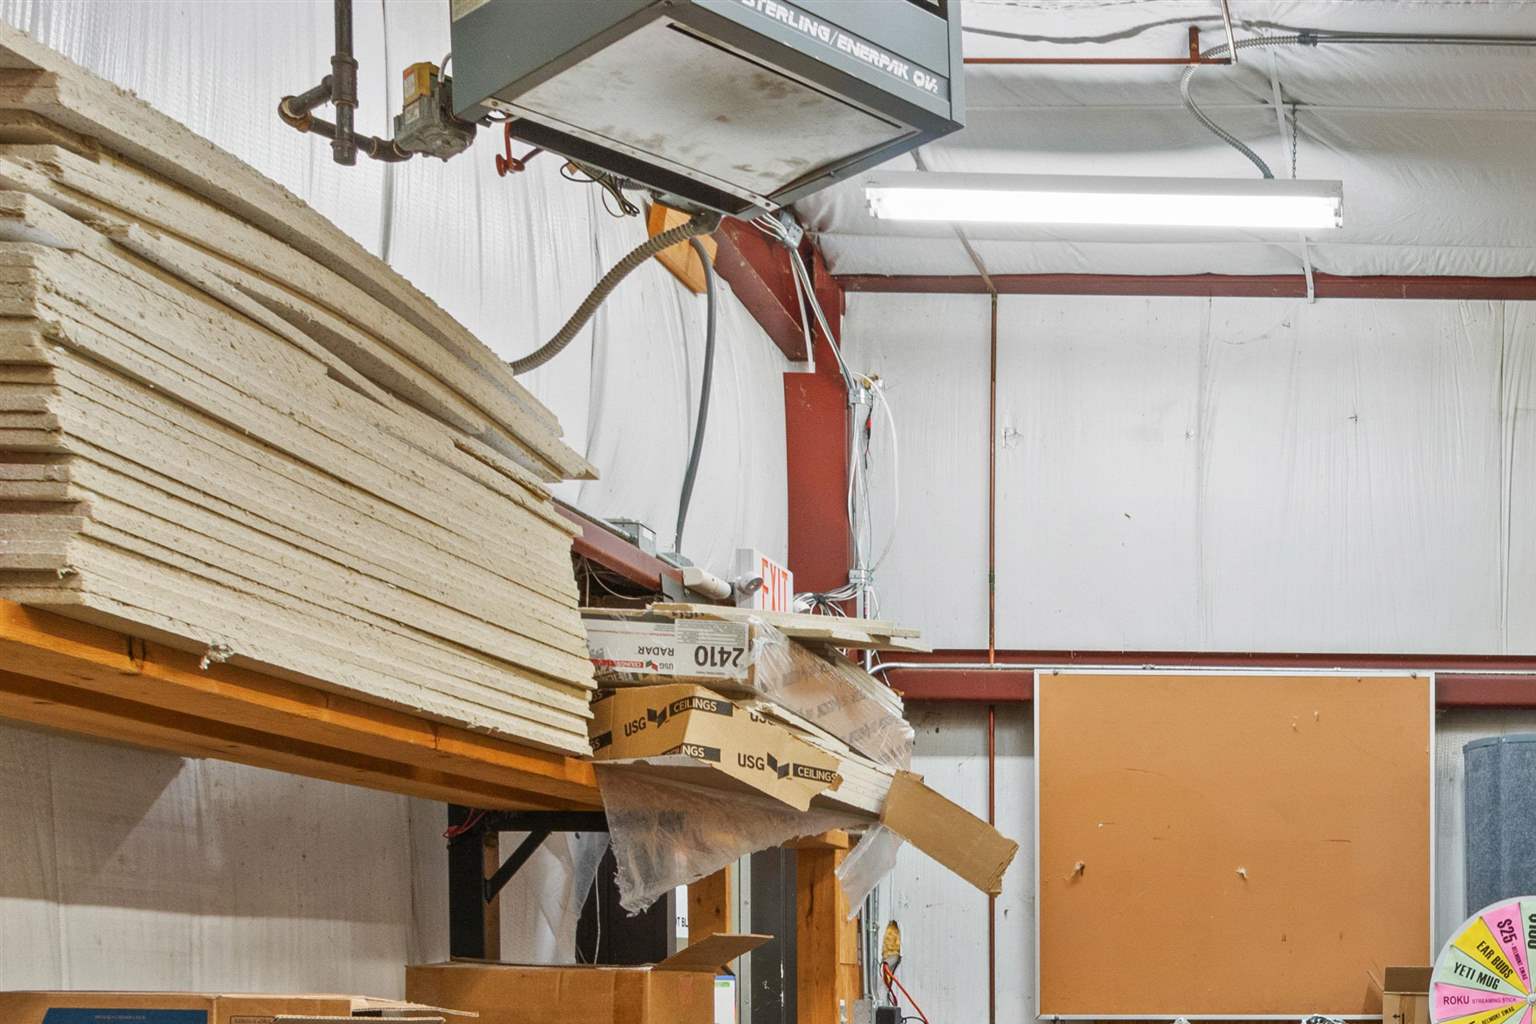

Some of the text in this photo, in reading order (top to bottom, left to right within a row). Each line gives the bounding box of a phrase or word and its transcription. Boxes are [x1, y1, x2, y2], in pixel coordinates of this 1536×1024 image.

[761, 557, 789, 613] EXIT
[637, 645, 675, 656] RADAR
[694, 645, 745, 669] 2410
[624, 696, 718, 738] USG CEILINGS
[737, 752, 837, 784] USG CEILINGS
[1497, 918, 1518, 944] $25
[1476, 940, 1514, 979] EAR BUDS
[1453, 962, 1501, 990] YETI MUG
[1443, 996, 1470, 1006] ROKU
